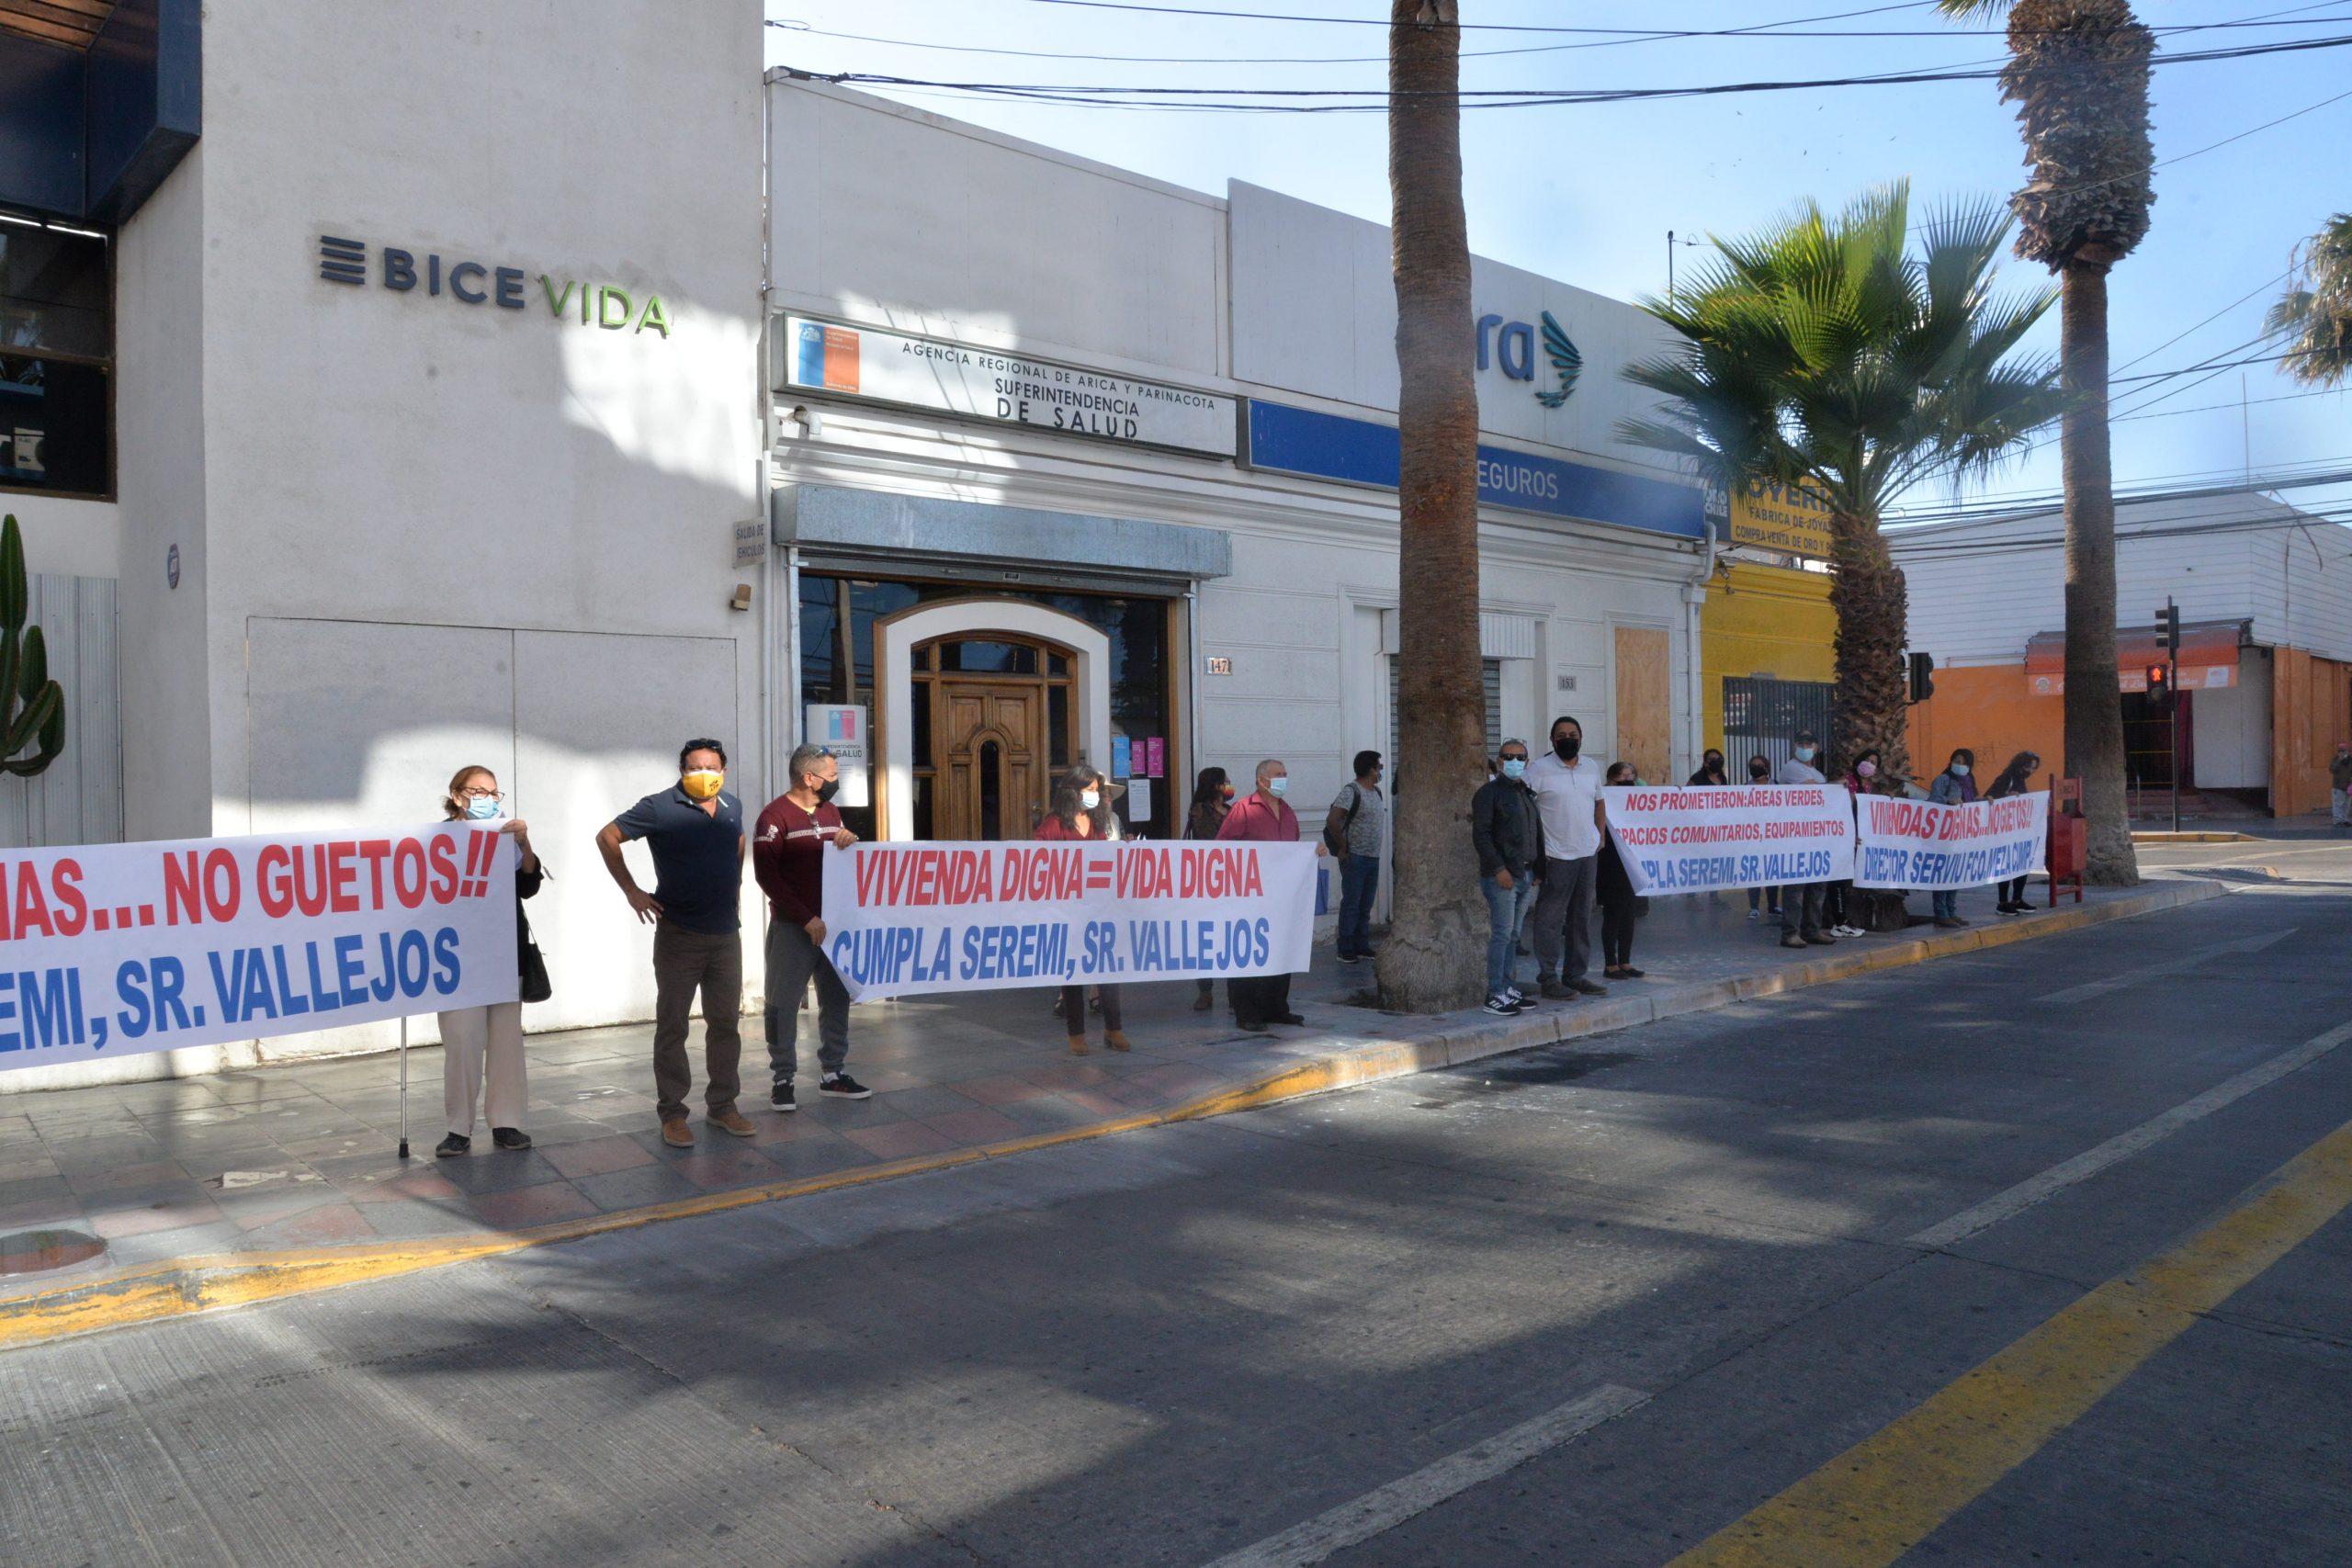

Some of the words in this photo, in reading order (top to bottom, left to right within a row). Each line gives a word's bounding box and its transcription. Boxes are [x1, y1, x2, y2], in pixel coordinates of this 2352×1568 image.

[383, 247, 526, 310] BICE
[542, 274, 670, 339] VIDA
[903, 343, 970, 365] AGENCIA
[979, 356, 1047, 378] REGIONAL
[1056, 371, 1070, 384] DE
[1079, 376, 1117, 392] ARICA
[1125, 384, 1131, 394] Y
[1138, 386, 1215, 411] PARINACOTA
[995, 378, 1139, 416] SUPERINTENDENCIA
[998, 398, 1029, 423] DE
[1054, 407, 1137, 439] SALUD
[1477, 460, 1558, 500] EGUROS
[1749, 506, 1791, 526] FABRICA
[1792, 515, 1804, 528] DE
[1792, 536, 1802, 548] DE
[1804, 537, 1818, 551] ORO
[1211, 660, 1227, 672] 147
[837, 750, 863, 758] SALUD
[1626, 794, 1657, 811] NOS
[1785, 790, 1825, 808] VERDES,
[1671, 822, 1763, 844] COMUNITARIOS,
[1765, 820, 1845, 840] EQUIPAMIENTOS
[255, 829, 500, 919] GUETOS!!
[856, 849, 992, 908] VIVIENDA
[1180, 848, 1263, 898] DIGNA
[1679, 855, 1737, 887] SEREMI,
[1739, 854, 1761, 883] SR.
[1763, 851, 1831, 881] VALLEJOS
[1864, 846, 1908, 883] DIRECTOR
[1910, 852, 1967, 885] SERVIU
[832, 927, 951, 986] CUMPLA
[960, 923, 1076, 982] SEREMI,
[1082, 920, 1124, 974] SR.
[1130, 917, 1270, 972] VALLEJOS
[117, 956, 206, 1038] SR.
[208, 927, 460, 1025] VALLEJOS
